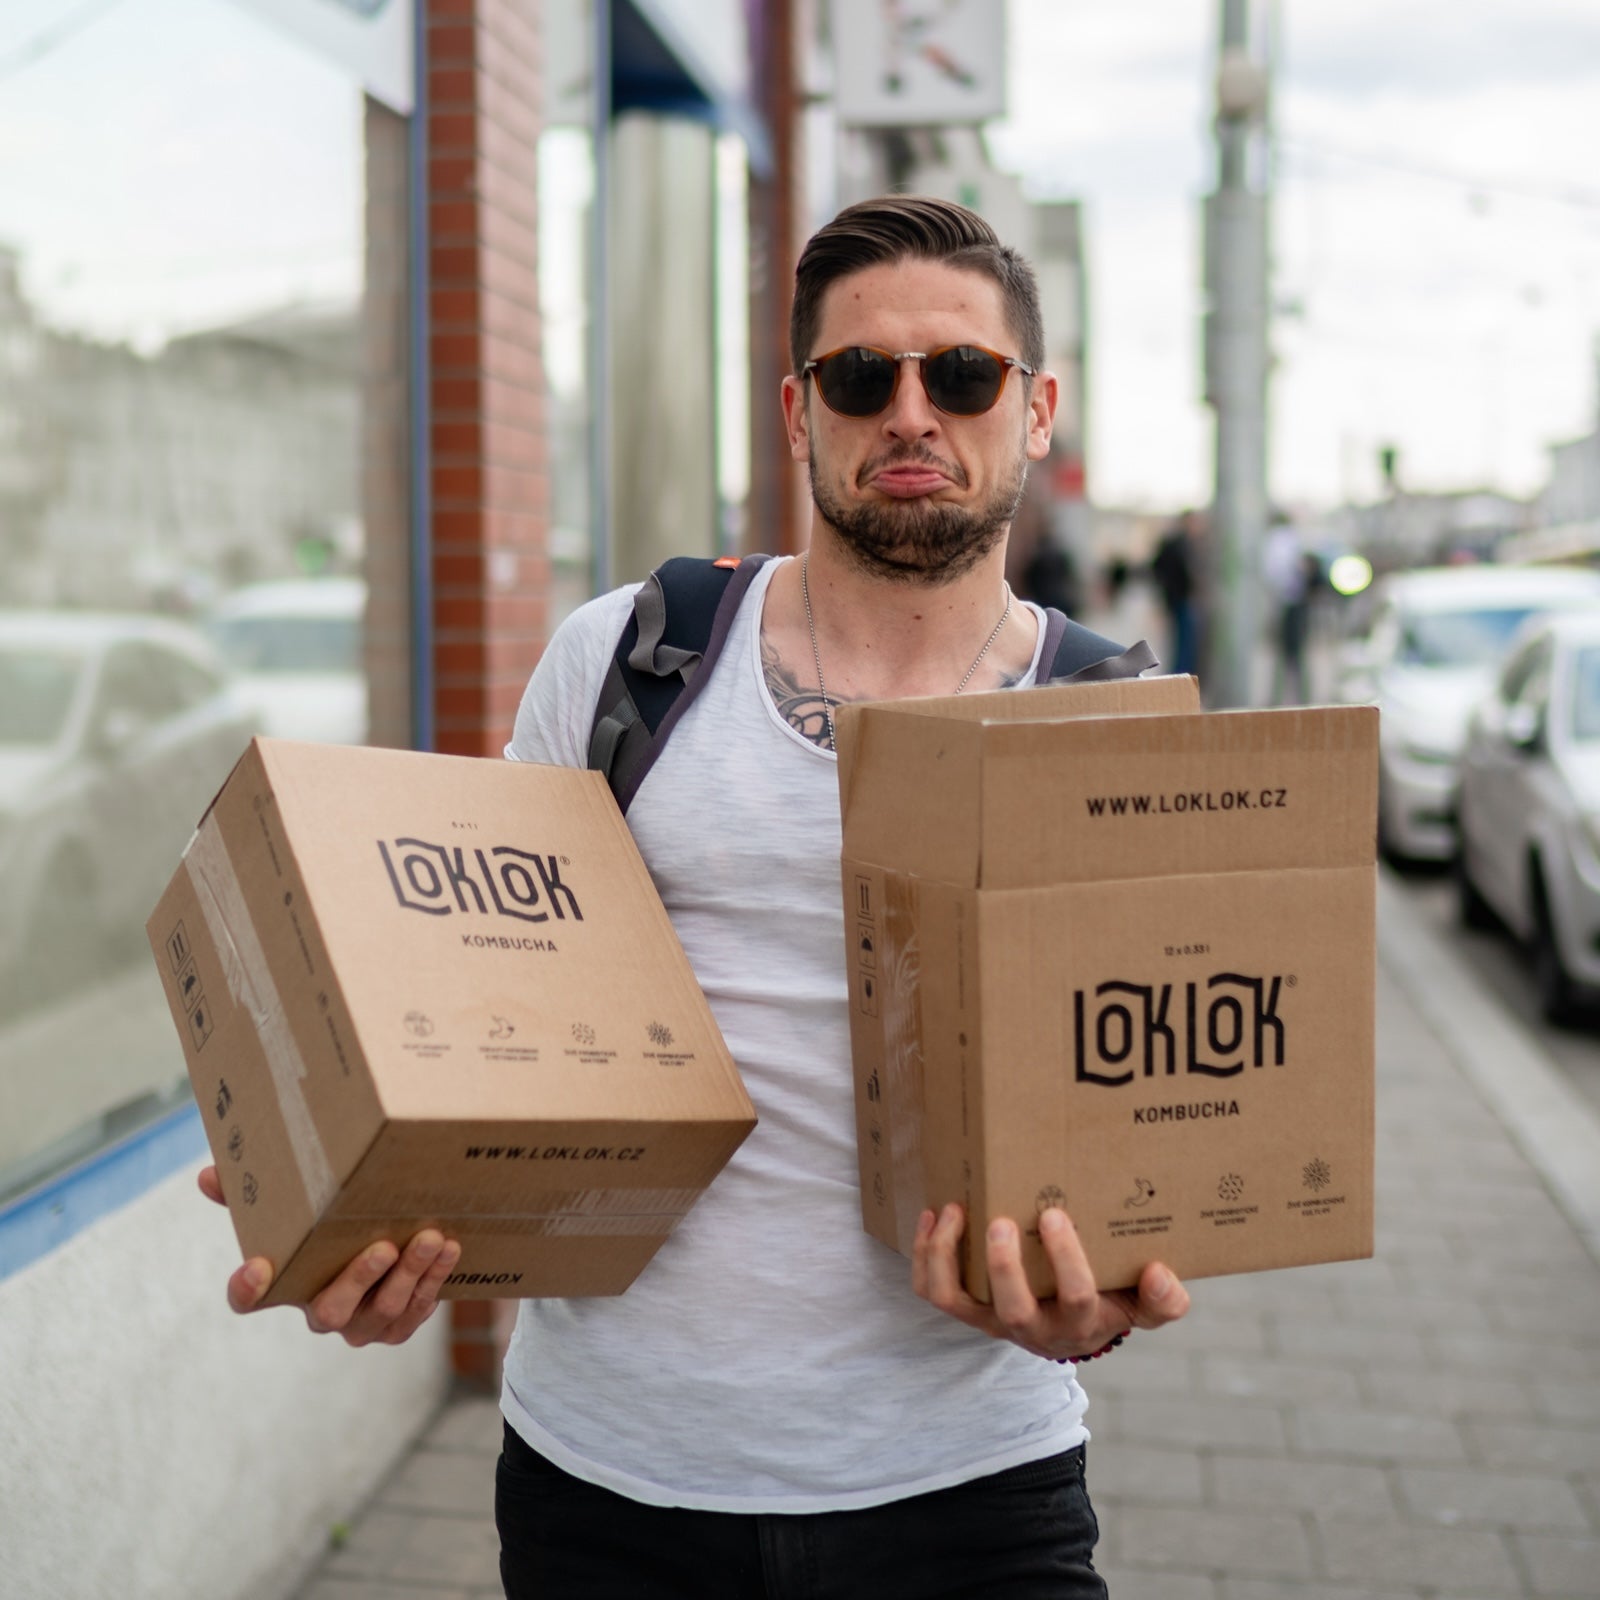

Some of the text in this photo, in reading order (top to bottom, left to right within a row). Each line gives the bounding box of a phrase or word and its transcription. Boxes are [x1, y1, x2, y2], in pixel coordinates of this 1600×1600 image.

[1086, 788, 1288, 818] WWW.LOKLOK.CZ
[462, 934, 559, 953] KOMBUCHA
[1133, 1101, 1240, 1125] KOMBUCHA
[465, 1145, 646, 1162] WWW.LOKLOK.CZ
[443, 1271, 524, 1285] KOMBU
